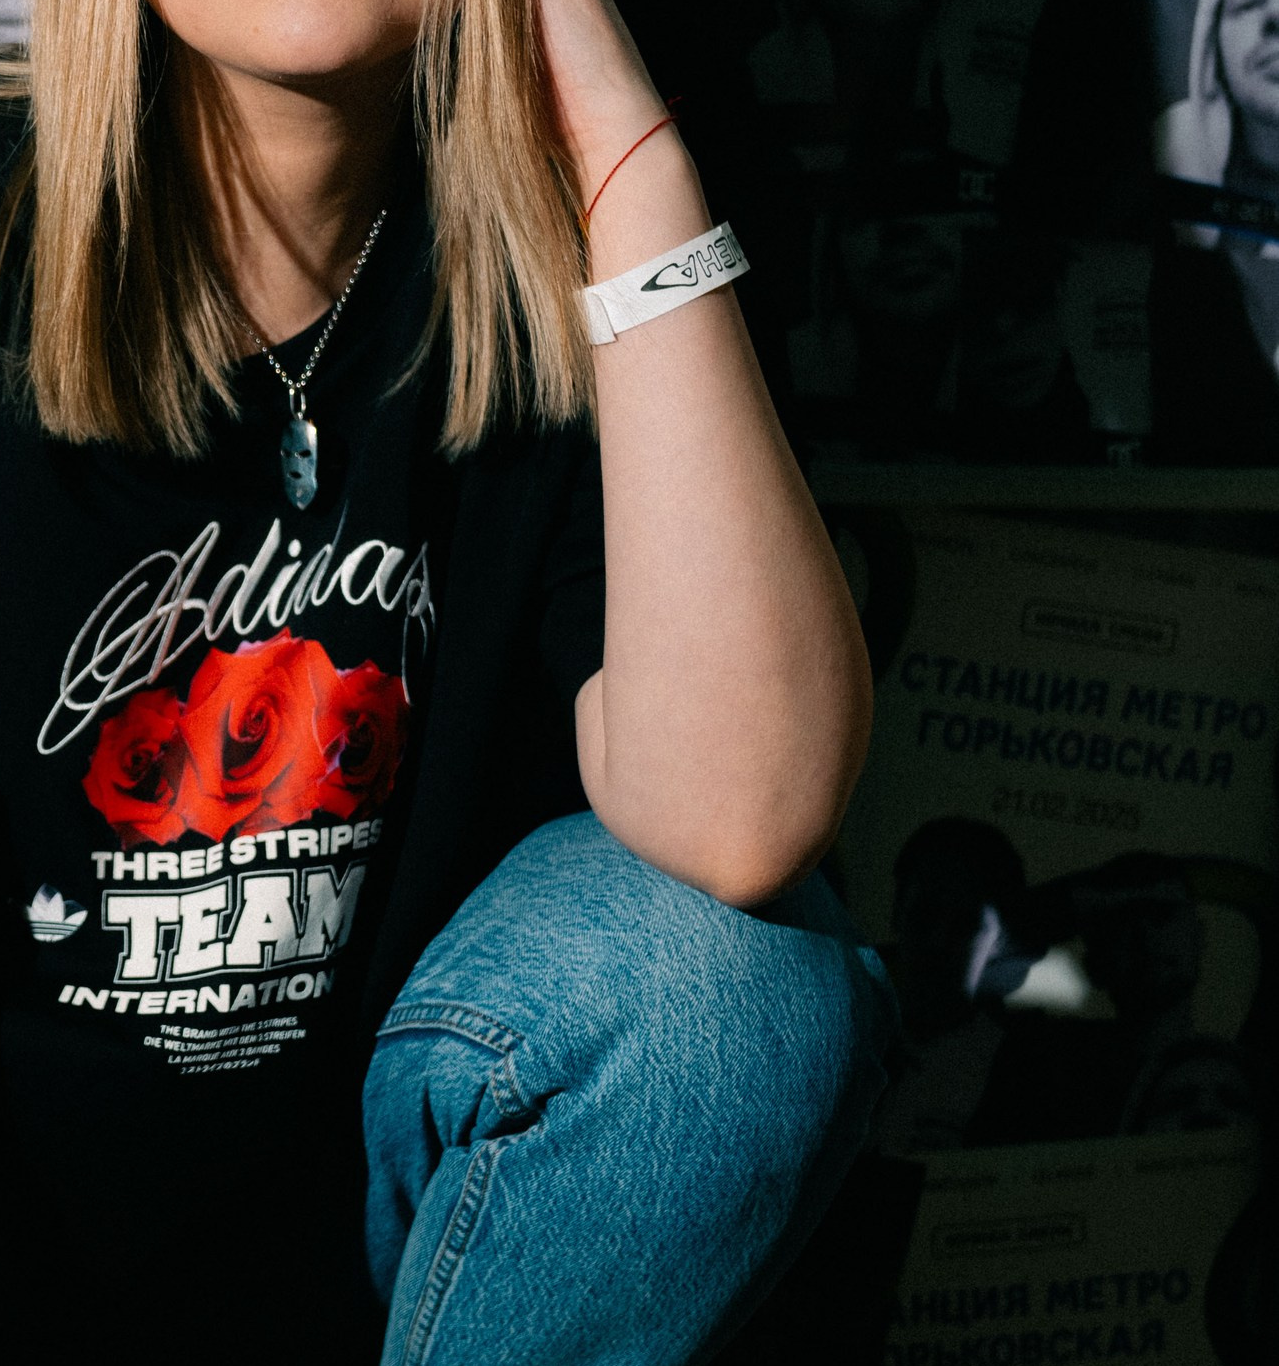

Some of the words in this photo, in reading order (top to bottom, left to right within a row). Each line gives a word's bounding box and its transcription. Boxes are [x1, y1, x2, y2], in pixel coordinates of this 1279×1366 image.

[900, 652, 1110, 716] СТАНЦИЯ
[1122, 686, 1269, 741] МЕТРО
[920, 709, 1234, 786] ГОРЬКОВСКАЯ
[91, 842, 225, 881] THREE
[229, 818, 383, 866] STRIPES
[101, 858, 369, 984] TEAM
[143, 1036, 162, 1048] DIE
[160, 1024, 181, 1036] THE
[182, 1027, 218, 1039] BRAND
[241, 1022, 257, 1033] THE
[167, 1055, 181, 1064] LA
[1045, 1267, 1192, 1315] МЕТРО
